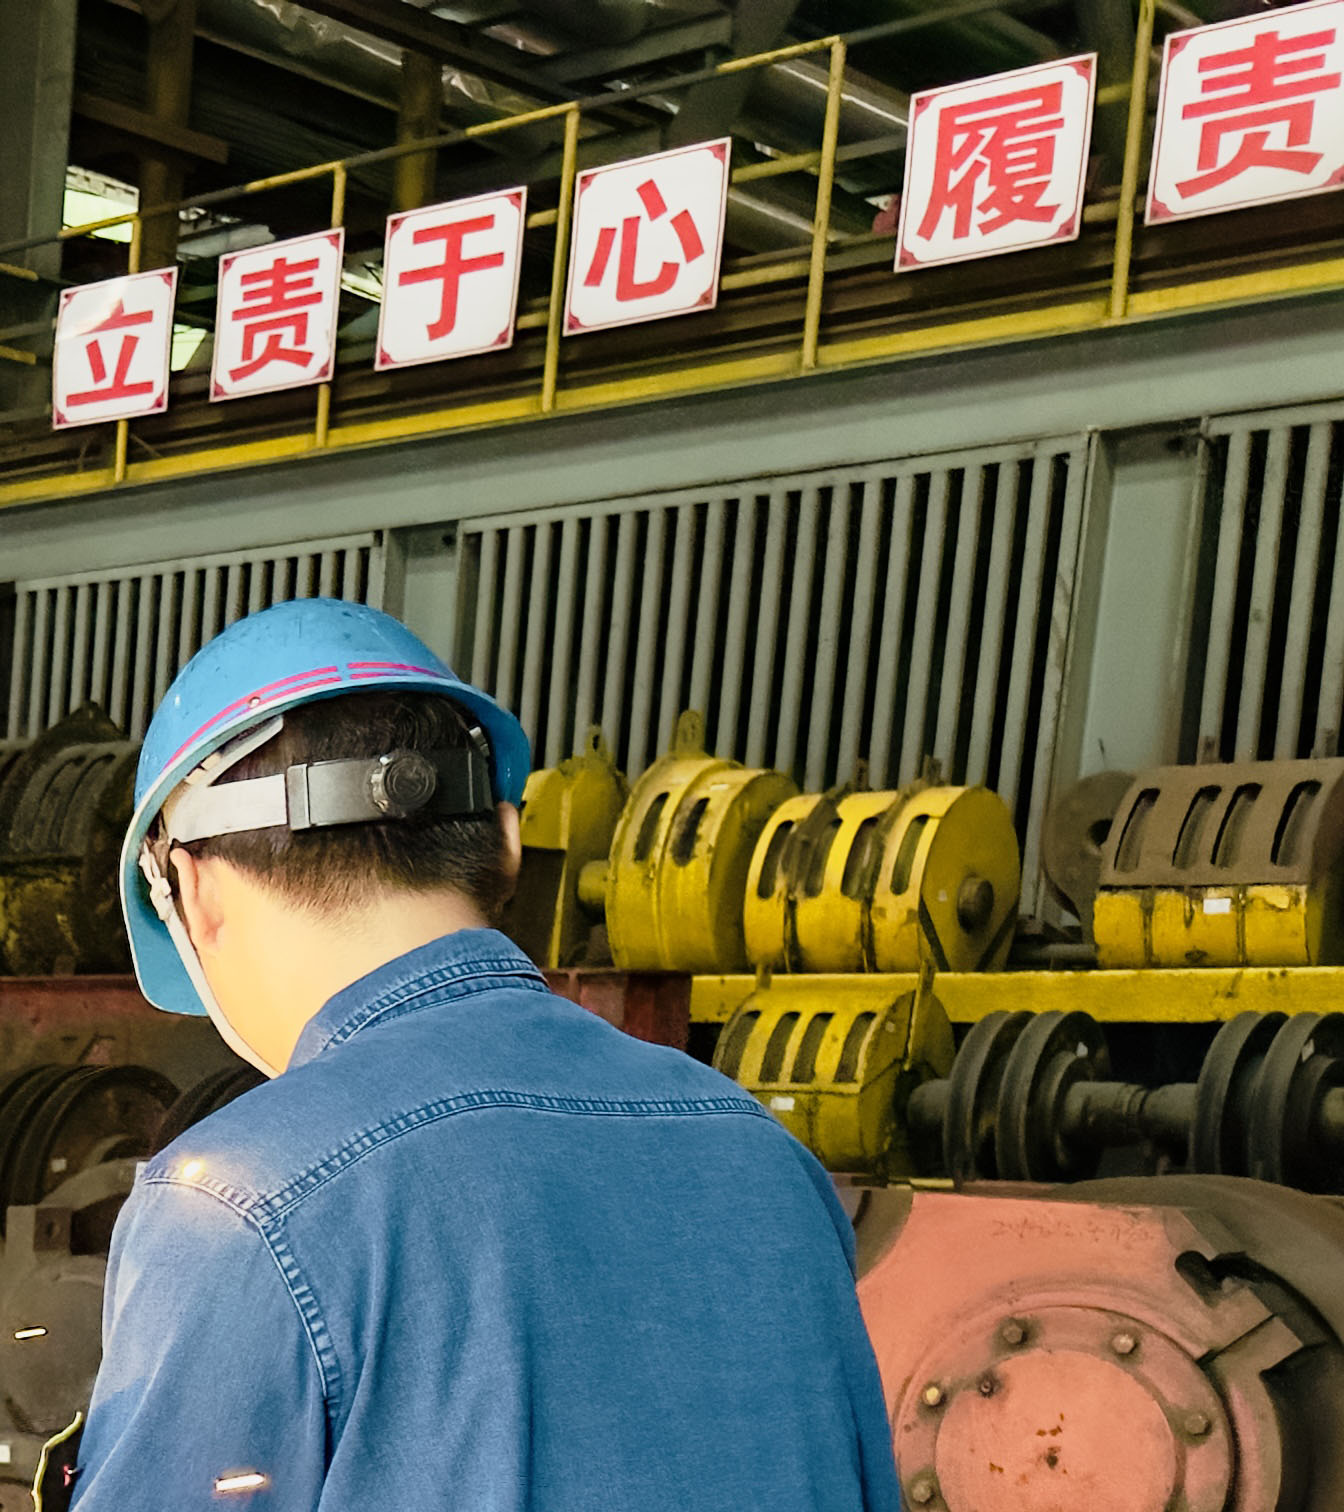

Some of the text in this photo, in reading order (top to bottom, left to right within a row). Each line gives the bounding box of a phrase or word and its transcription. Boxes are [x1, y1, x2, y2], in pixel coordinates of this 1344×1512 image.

[65, 28, 1343, 408] 立责于心 履责
